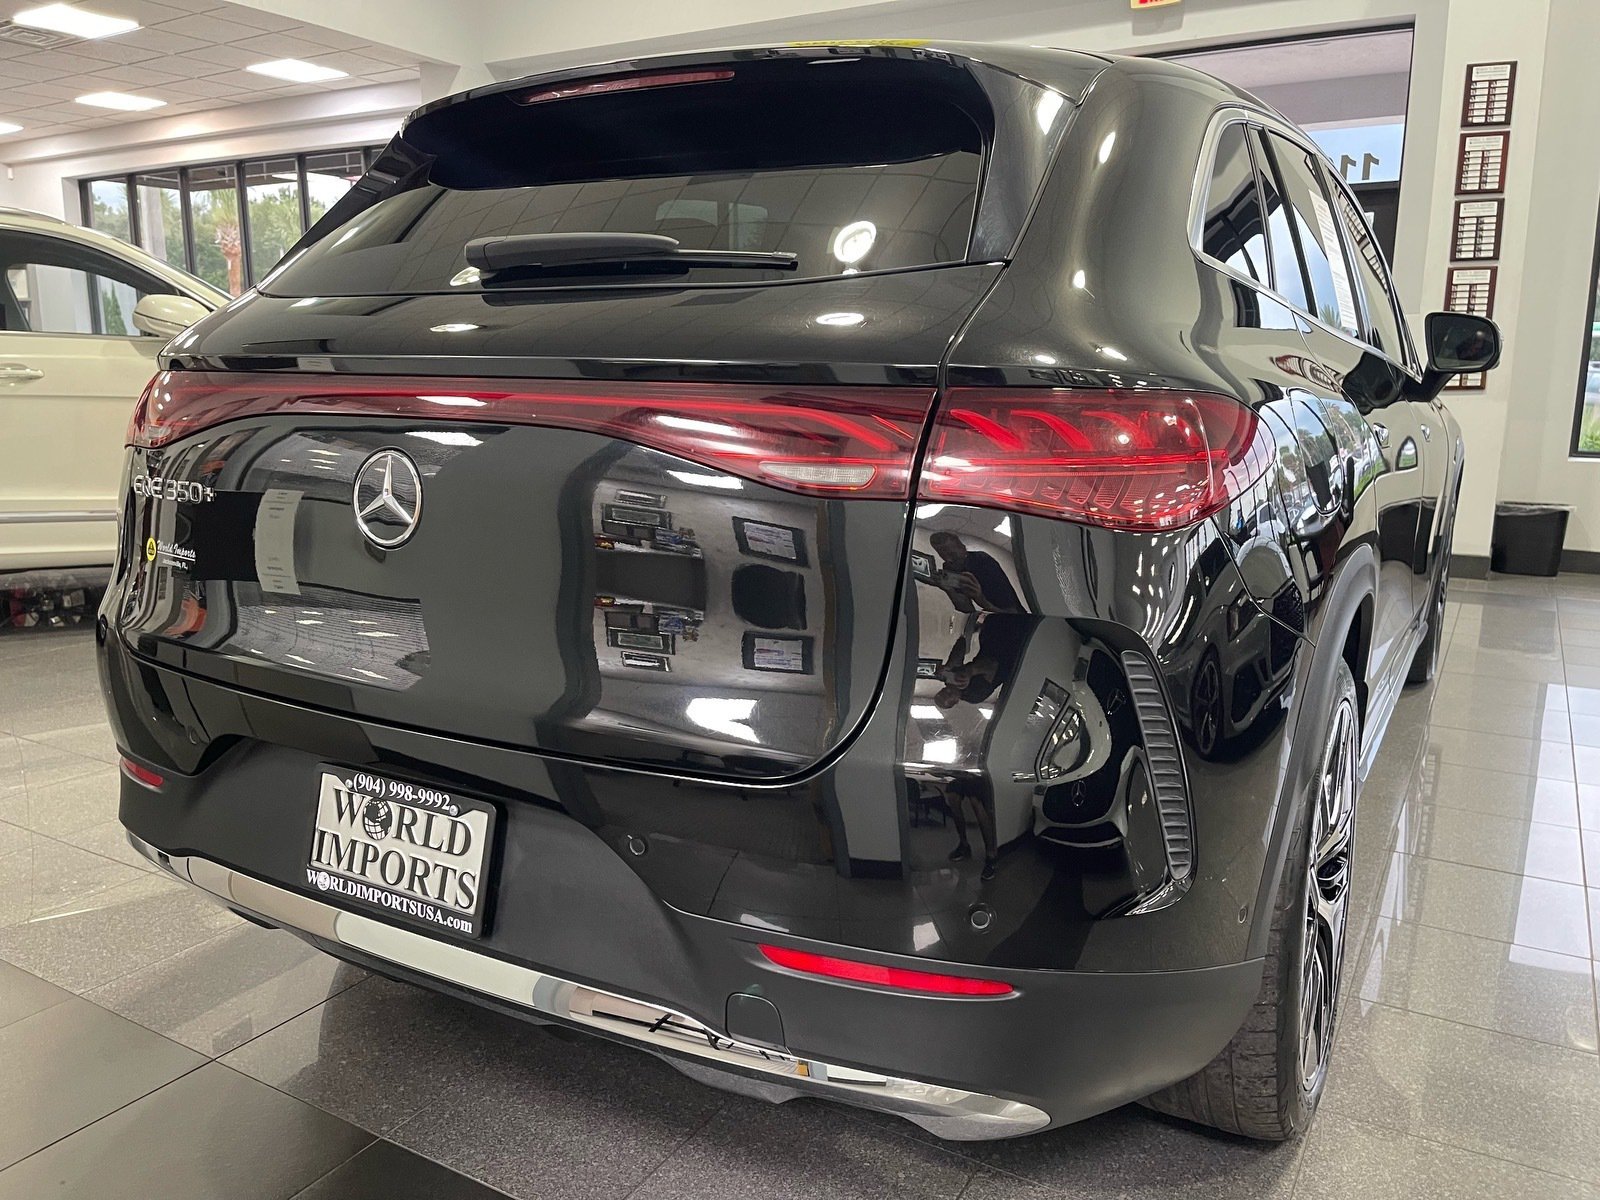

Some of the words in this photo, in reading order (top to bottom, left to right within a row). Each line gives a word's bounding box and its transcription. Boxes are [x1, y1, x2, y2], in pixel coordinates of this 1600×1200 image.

[133, 474, 163, 500] EQE
[156, 540, 174, 553] World
[173, 543, 197, 559] Imports
[353, 773, 386, 797] (904)
[389, 783, 451, 811] 998-9992
[333, 787, 473, 857] WORLD
[313, 829, 477, 910] IMPORTS
[306, 868, 474, 934] WORLDIMPORTSUSA.com
